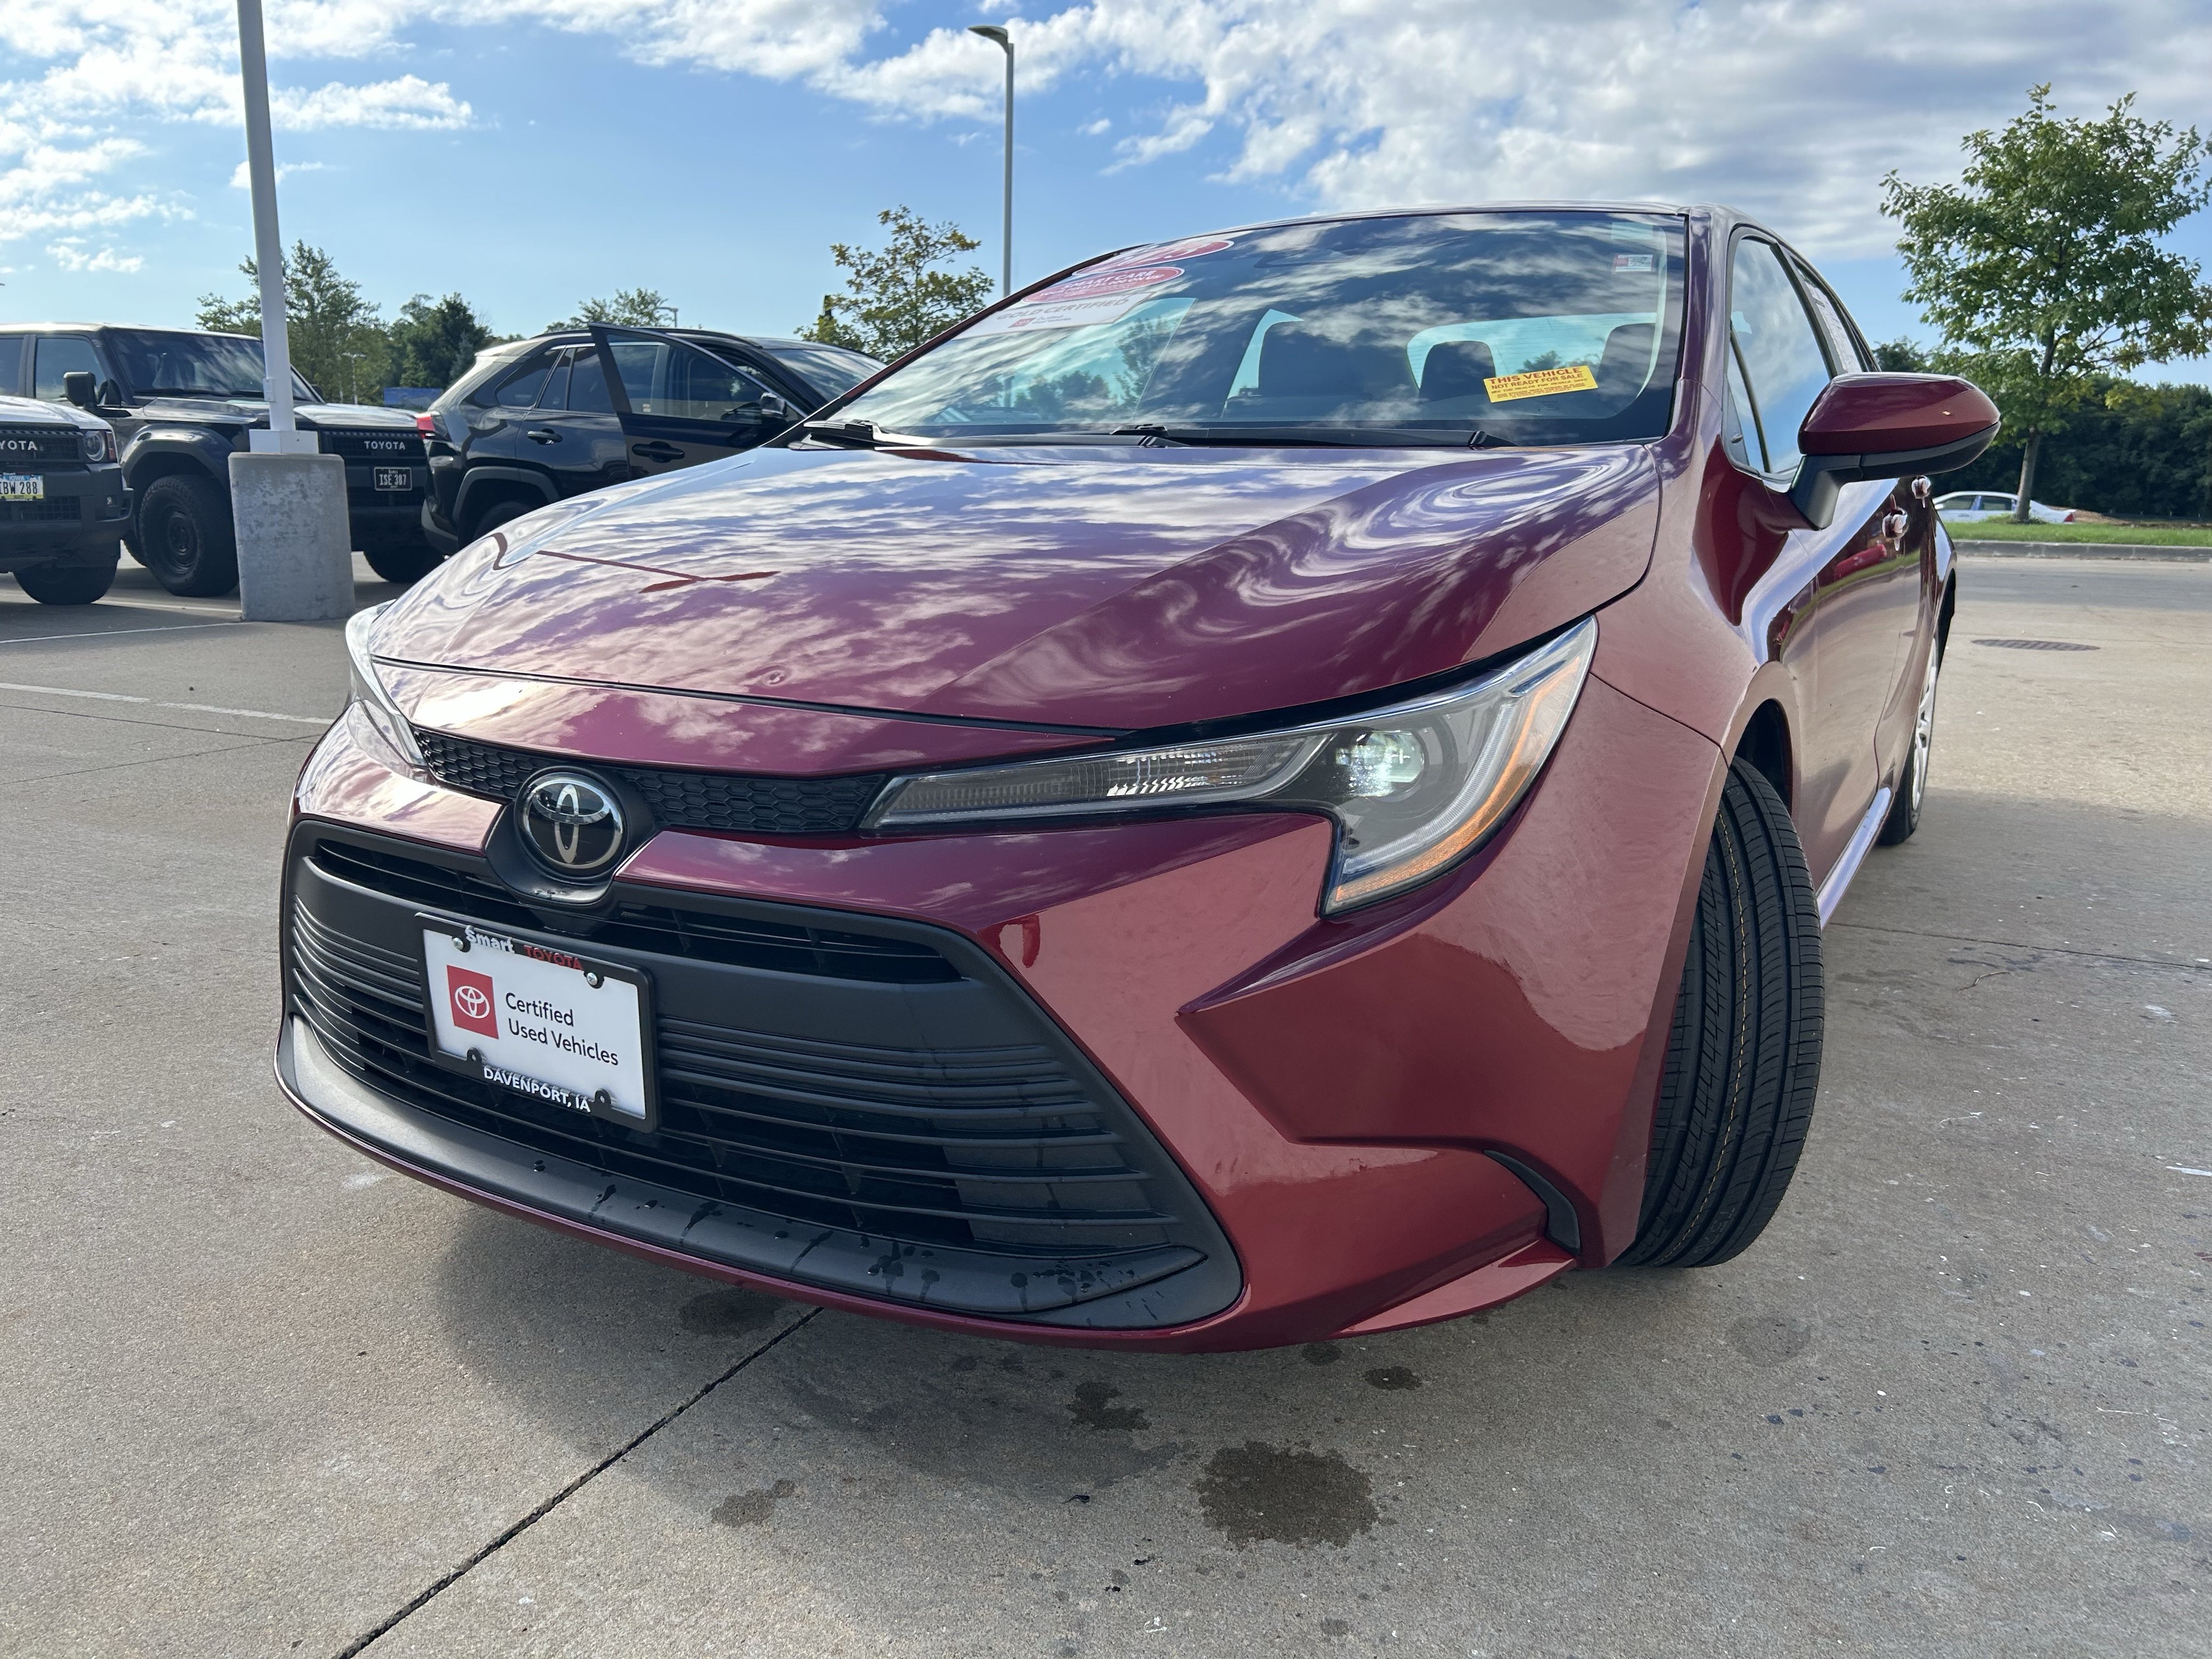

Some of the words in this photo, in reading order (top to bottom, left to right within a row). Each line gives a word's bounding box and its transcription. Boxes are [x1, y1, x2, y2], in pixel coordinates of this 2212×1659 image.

[997, 309, 1043, 320] GOLD
[1043, 299, 1129, 314] CERTIFIED
[1488, 375, 1521, 385] THIS
[1523, 367, 1582, 379] VEHICLE
[1510, 379, 1539, 387] READY
[364, 441, 406, 450] TOYOTA
[20, 481, 38, 494] 288
[379, 473, 393, 486] ISE
[465, 926, 515, 954] Smart
[524, 945, 583, 971] TOYOTA
[505, 992, 574, 1027] Certified
[508, 1018, 548, 1045] Used
[551, 1030, 619, 1066] Vehicles
[483, 1067, 573, 1108] DAVENPORT,
[575, 1096, 591, 1113] IA
